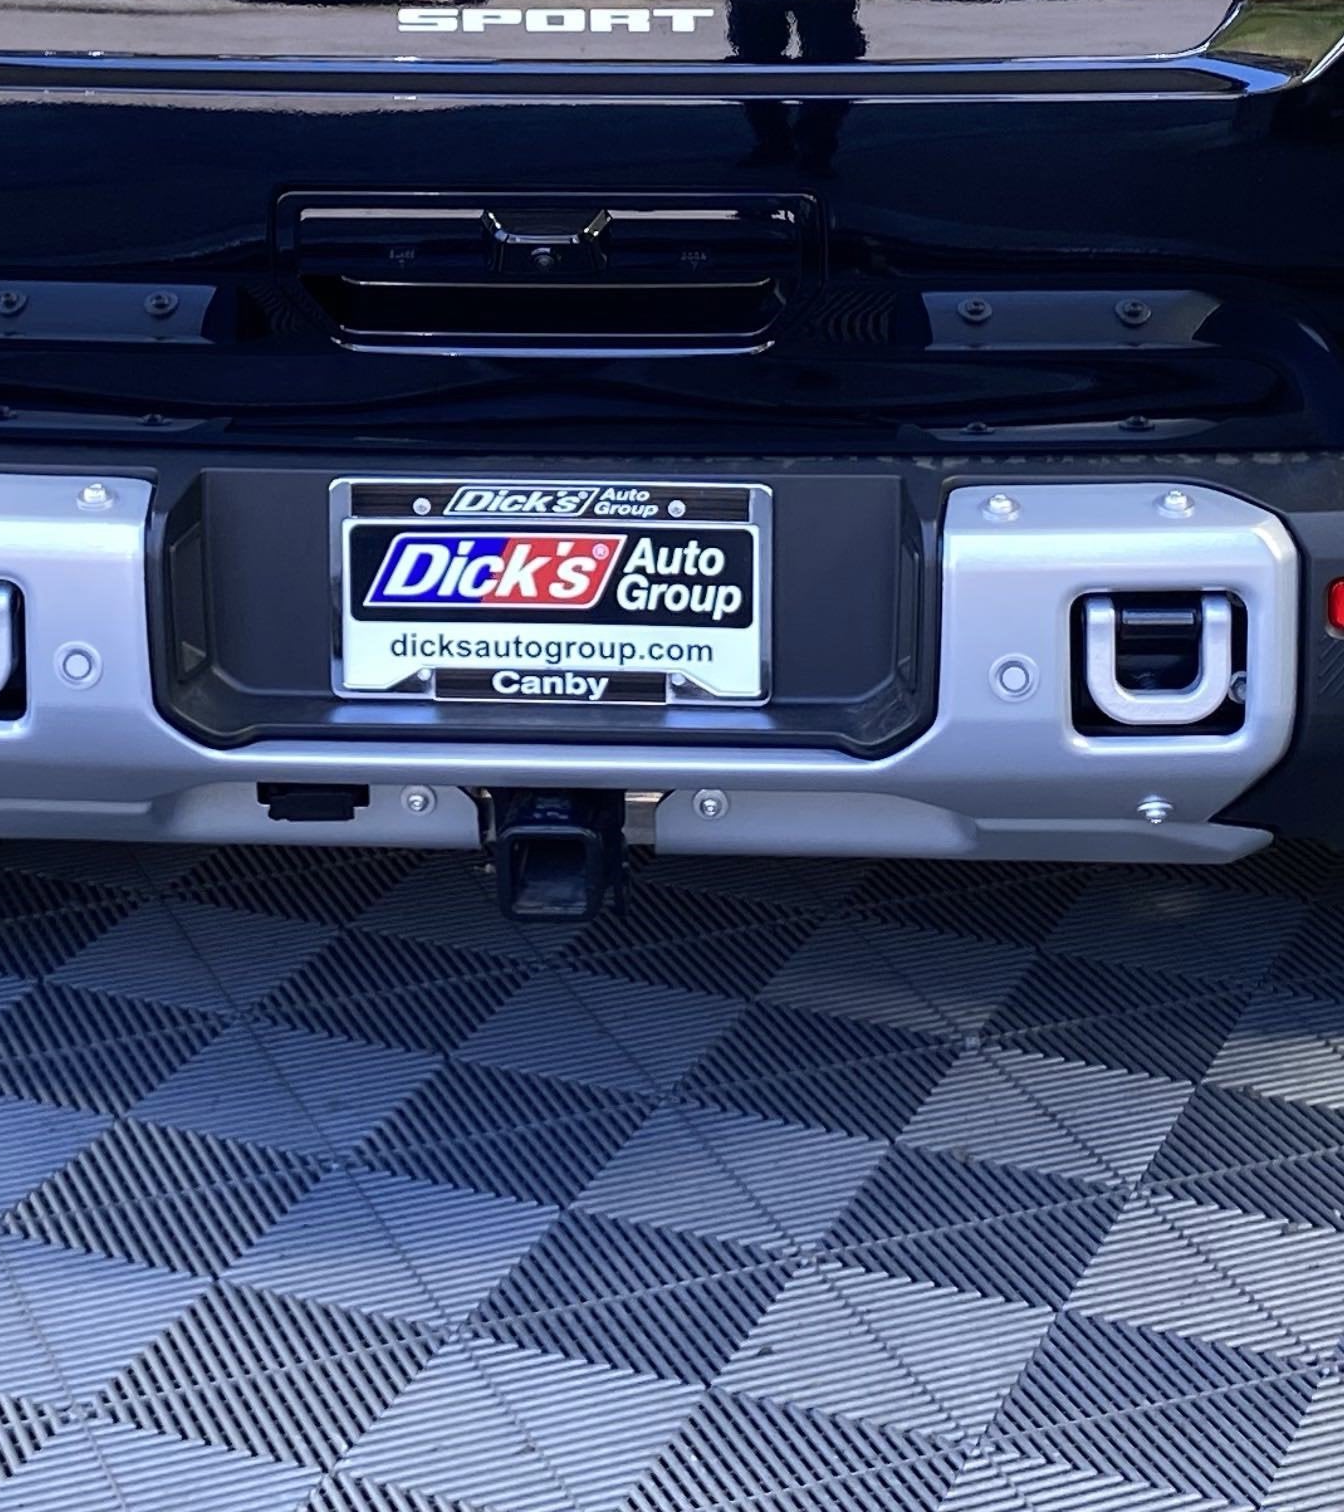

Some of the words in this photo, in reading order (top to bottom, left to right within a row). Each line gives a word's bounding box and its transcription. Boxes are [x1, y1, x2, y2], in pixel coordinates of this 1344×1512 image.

[397, 7, 714, 33] SPORT
[454, 489, 582, 513] Dick's
[593, 501, 660, 518] Group
[599, 488, 651, 502] Auto
[382, 539, 598, 599] Dick's
[623, 538, 726, 576] Auto
[616, 573, 743, 620] Group
[390, 633, 714, 664] dicksautogroup.com
[492, 670, 609, 700] Canby
